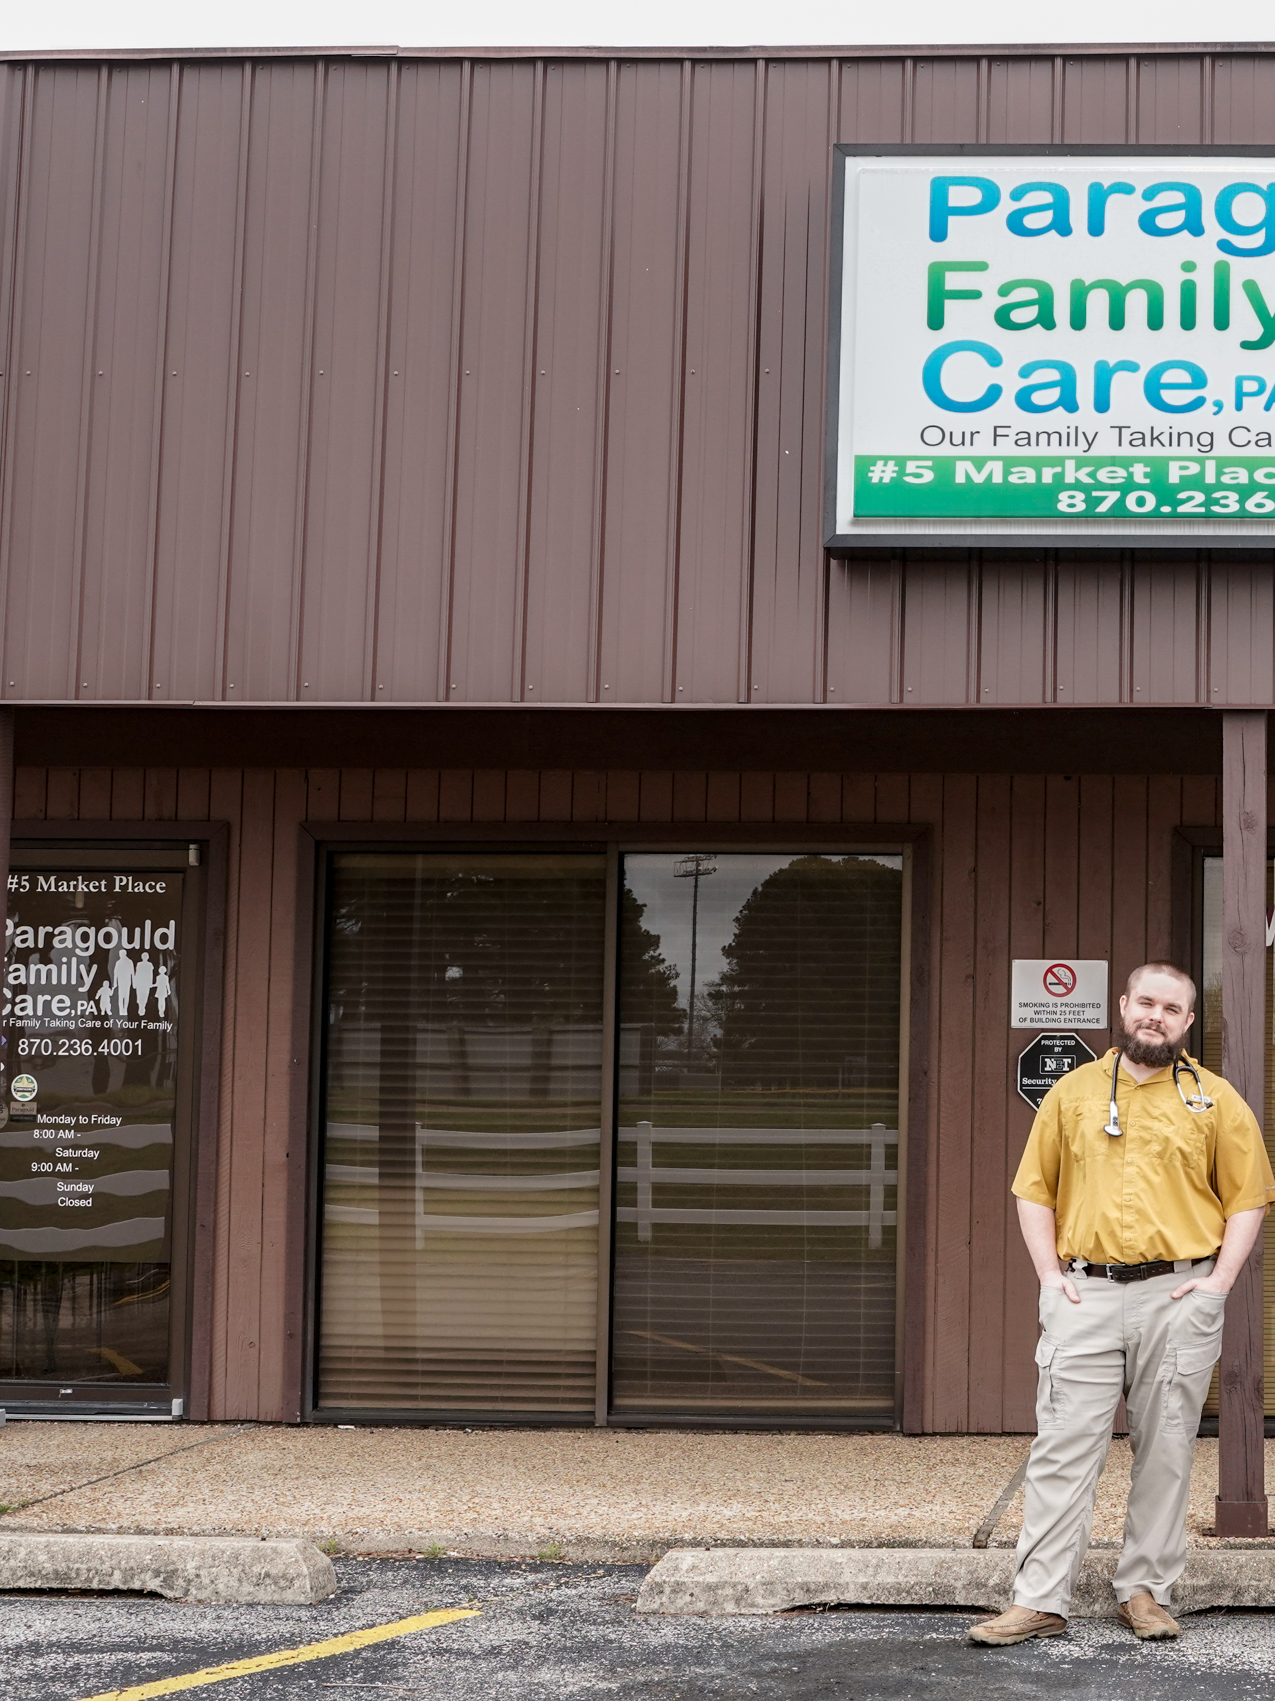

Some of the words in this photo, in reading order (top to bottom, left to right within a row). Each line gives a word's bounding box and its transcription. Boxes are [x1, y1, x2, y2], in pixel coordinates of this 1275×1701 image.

[920, 425, 981, 447] Our
[992, 425, 1099, 453] Family
[1110, 426, 1215, 453] Taking
[867, 460, 935, 484] #5
[954, 459, 1151, 484] Market
[7, 874, 30, 893] #5
[36, 875, 107, 893] Market
[113, 875, 166, 893] Place
[77, 1000, 98, 1016] PA
[9, 1018, 41, 1028] Family
[43, 1019, 75, 1029] Taking
[78, 1019, 101, 1028] Care
[104, 1019, 114, 1029] of
[116, 1020, 139, 1029] Your
[141, 1020, 173, 1032] Family
[18, 1039, 143, 1056] 870.236.4001
[1022, 1077, 1057, 1086] Security
[37, 1114, 76, 1126] Monday
[79, 1115, 88, 1124] to
[91, 1114, 122, 1126] Friday
[33, 1129, 55, 1139] 8:00
[57, 1129, 75, 1139] AM
[55, 1147, 100, 1160] Saturday
[31, 1162, 53, 1172] 9:00
[55, 1163, 72, 1172] AM
[56, 1182, 94, 1194] Sunday
[57, 1197, 92, 1207] Closed
